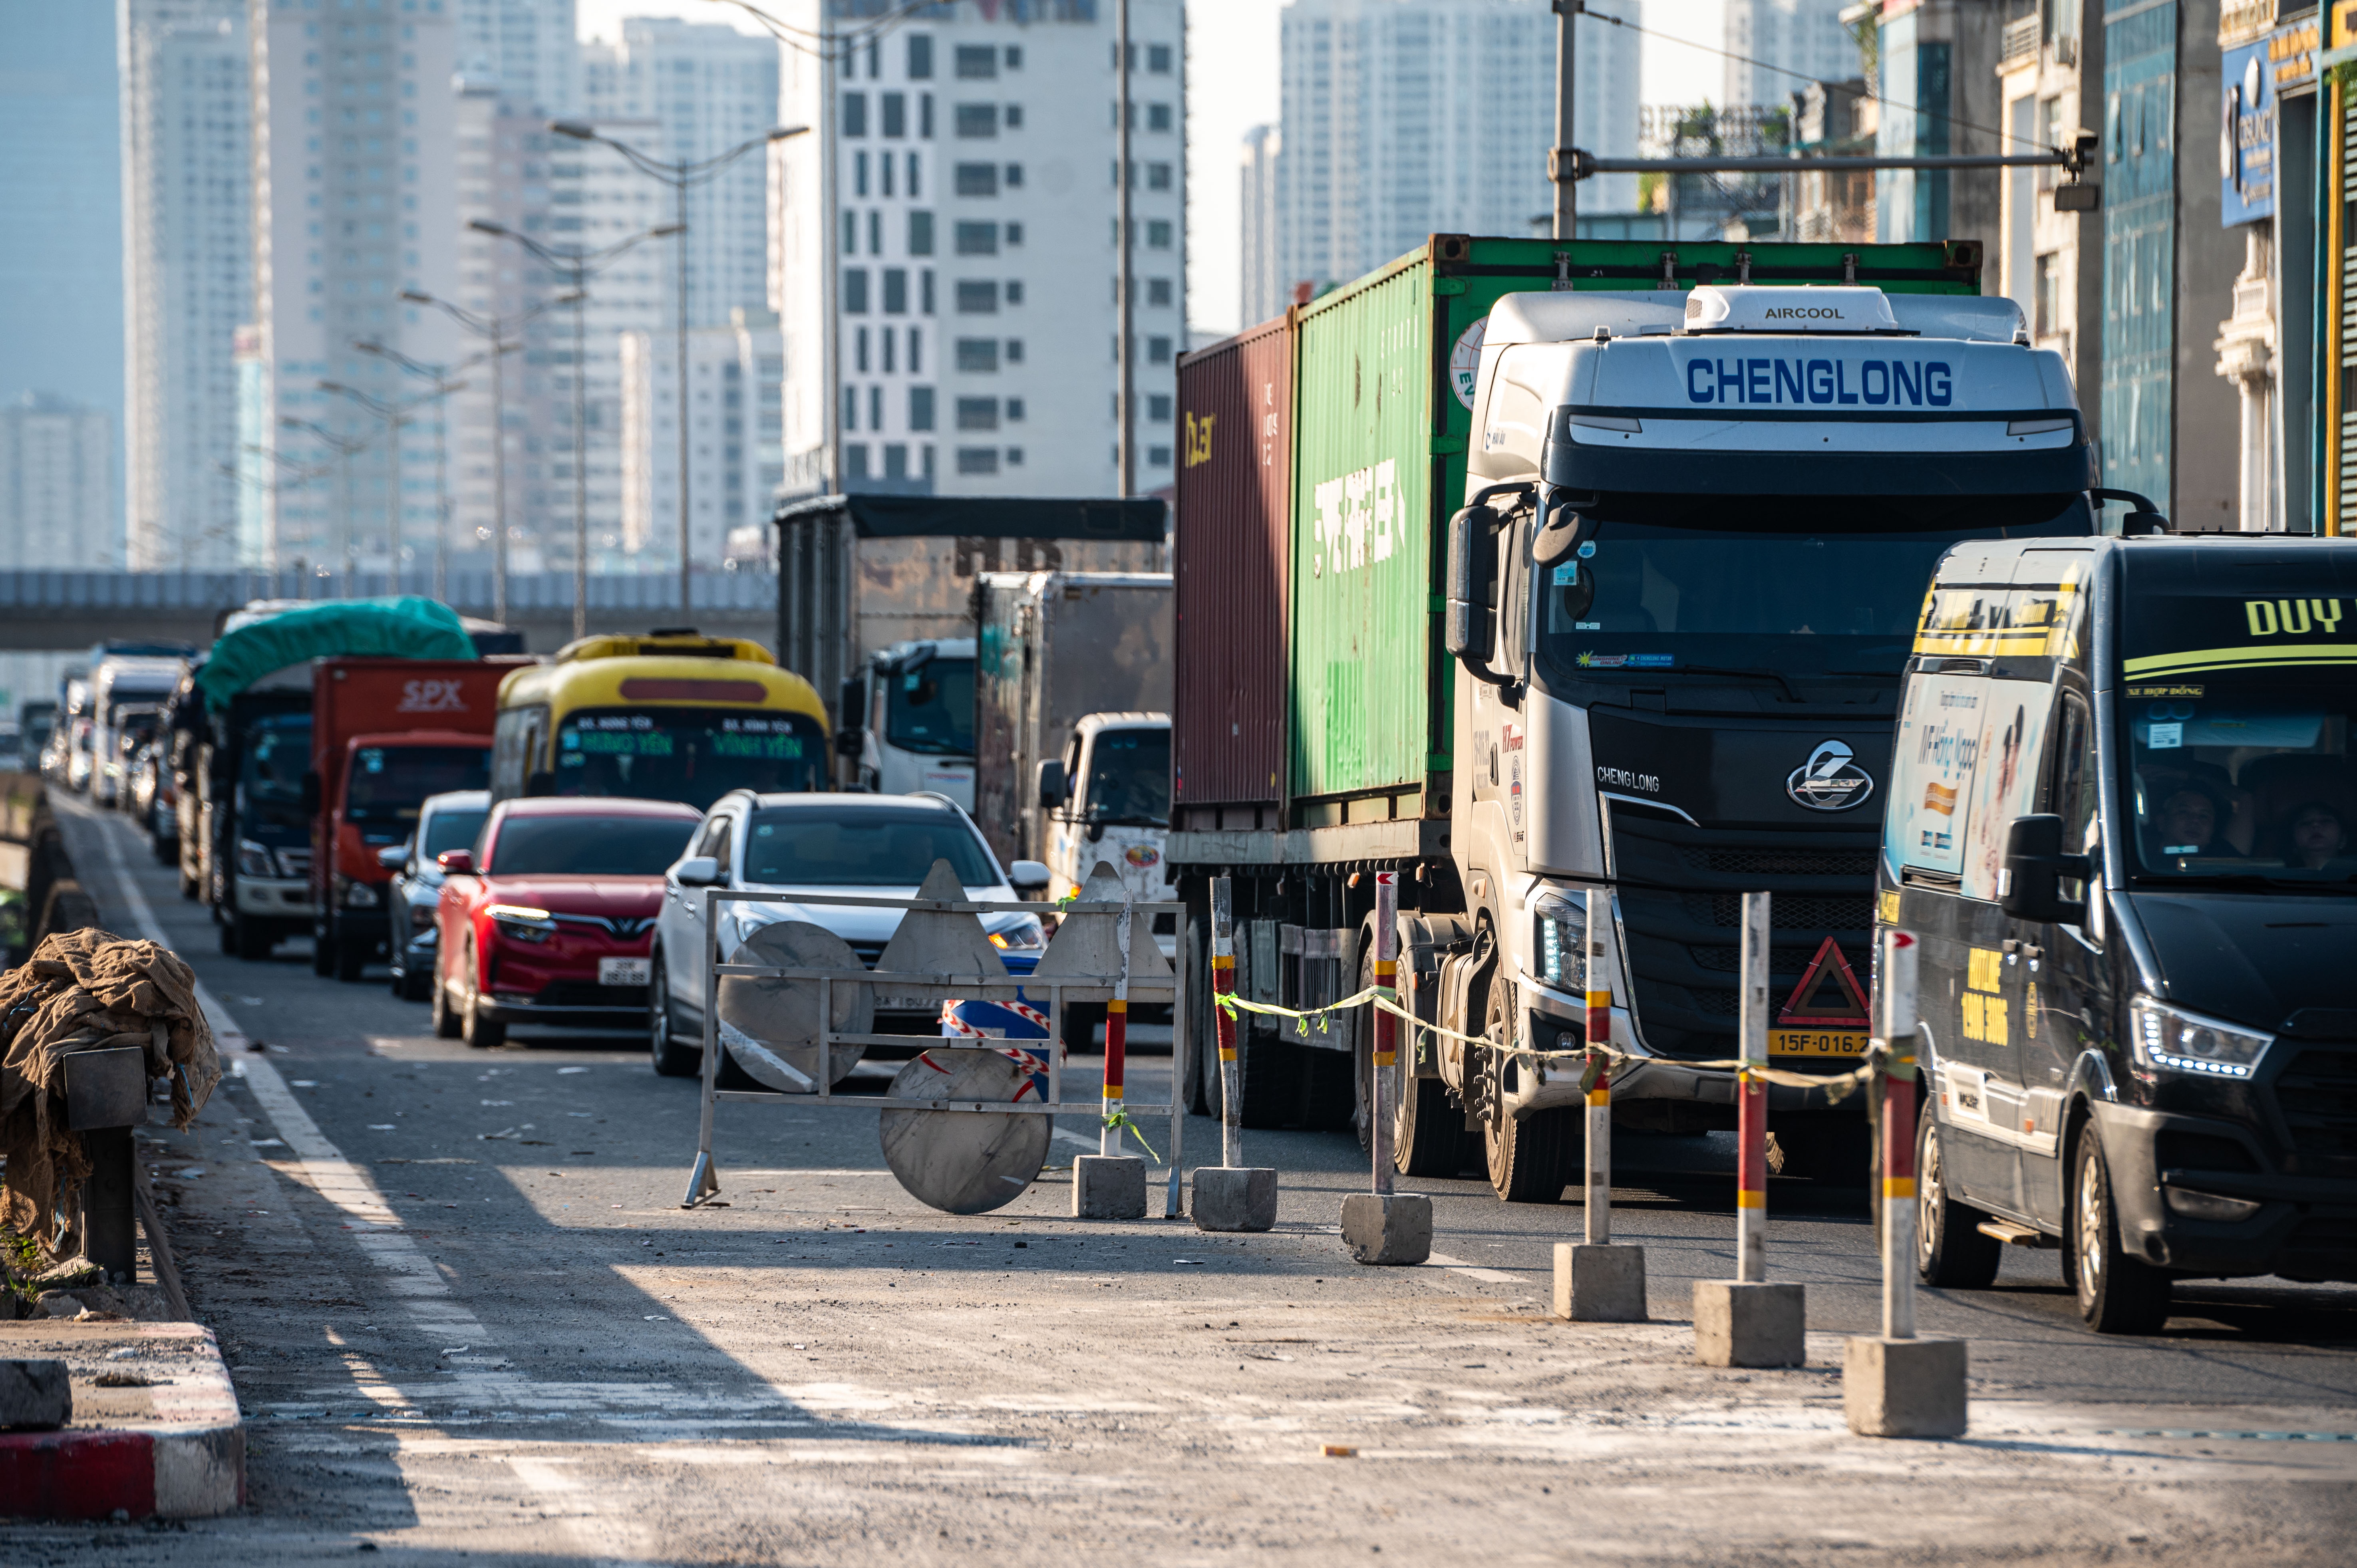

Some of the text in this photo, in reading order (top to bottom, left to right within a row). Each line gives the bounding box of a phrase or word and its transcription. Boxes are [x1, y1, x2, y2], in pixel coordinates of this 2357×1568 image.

[1765, 308, 1844, 319] AIRCOOL
[1687, 358, 1952, 407] CHENGLONG
[2245, 599, 2342, 635] DUY
[403, 679, 463, 706] SPX
[1502, 724, 1523, 754] H7 POWER
[1779, 1034, 1870, 1053] 15F-016.2
